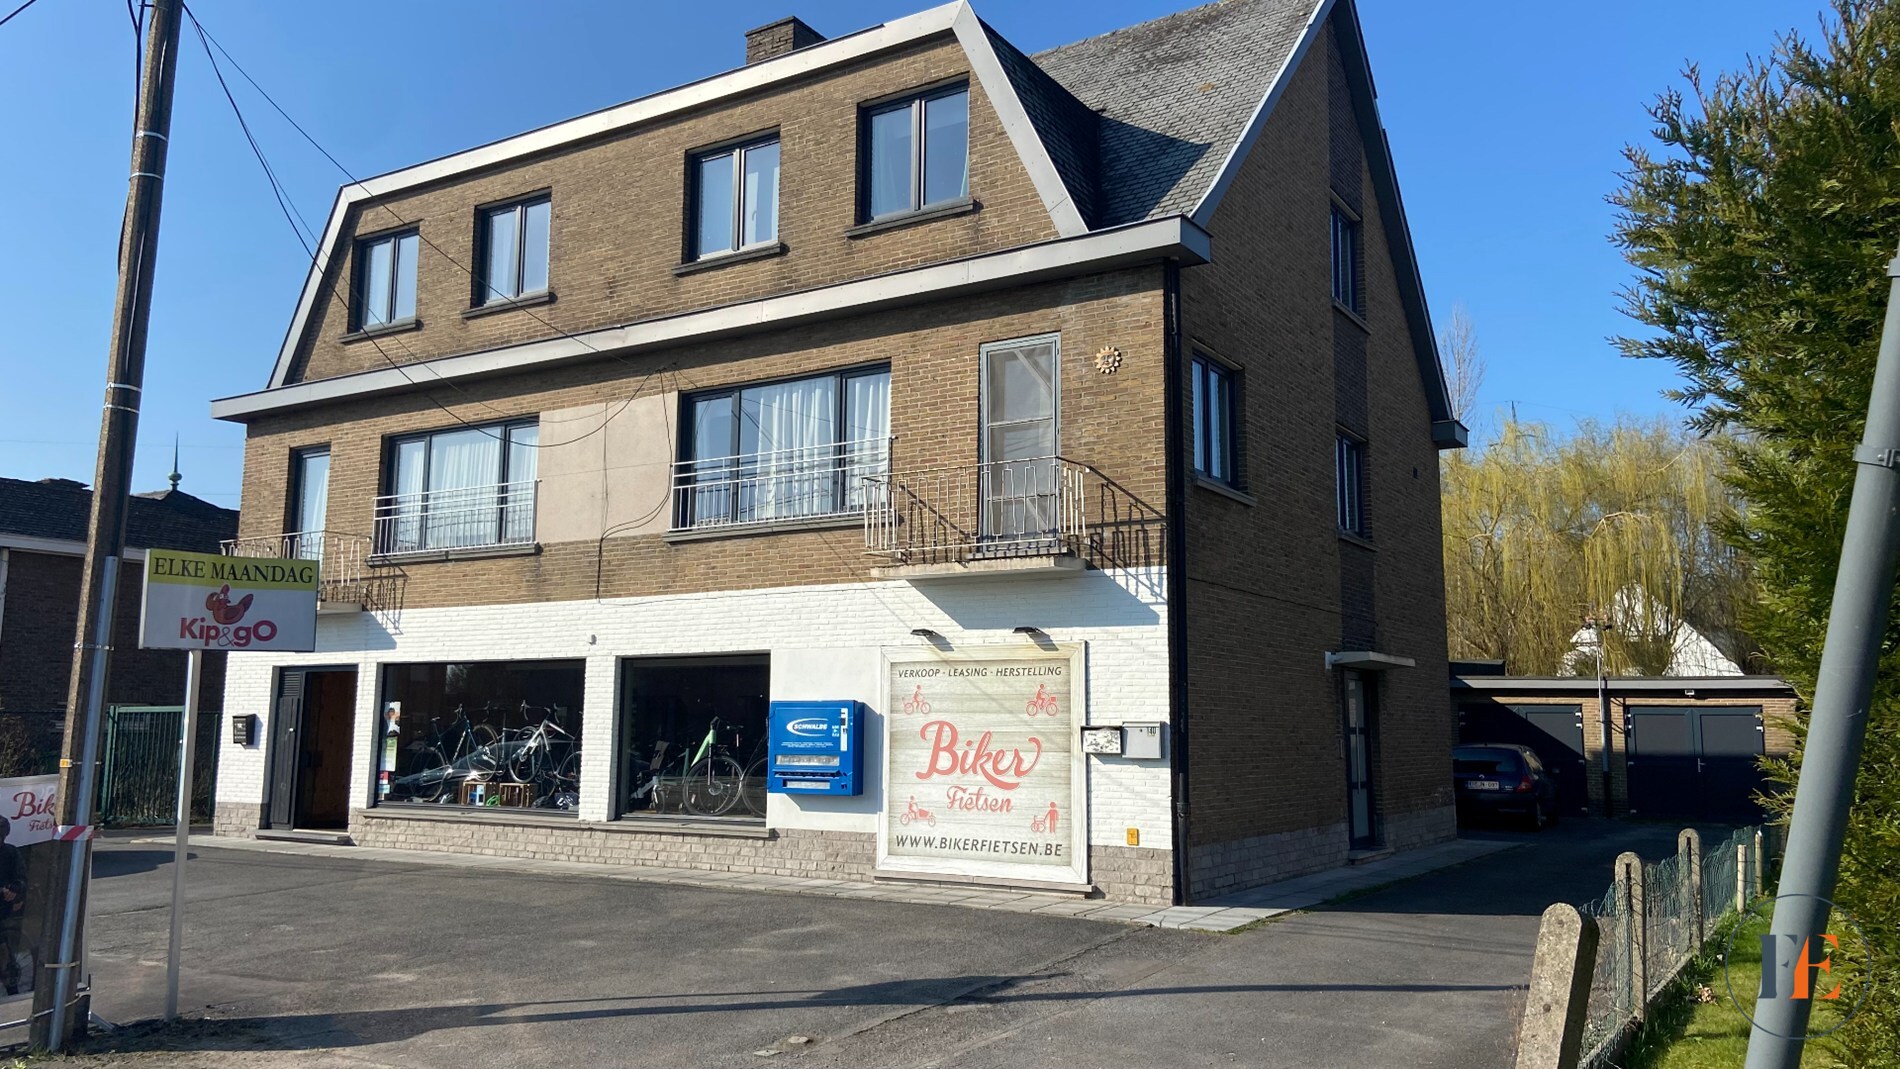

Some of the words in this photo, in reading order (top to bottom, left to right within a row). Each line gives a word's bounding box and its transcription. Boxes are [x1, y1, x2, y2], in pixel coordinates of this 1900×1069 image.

[153, 556, 206, 578] ELKE
[211, 561, 313, 584] MAANDAG
[898, 668, 941, 678] VERKOOP
[948, 667, 988, 677] LEASING
[995, 666, 1062, 677] HERSTELLING
[915, 720, 1042, 791] Biker
[10, 791, 55, 820] Bik
[946, 785, 1013, 813] Fietsen
[29, 819, 54, 832] Fiets
[895, 835, 1063, 857] WWW.BIKERFIETSEN.BE
